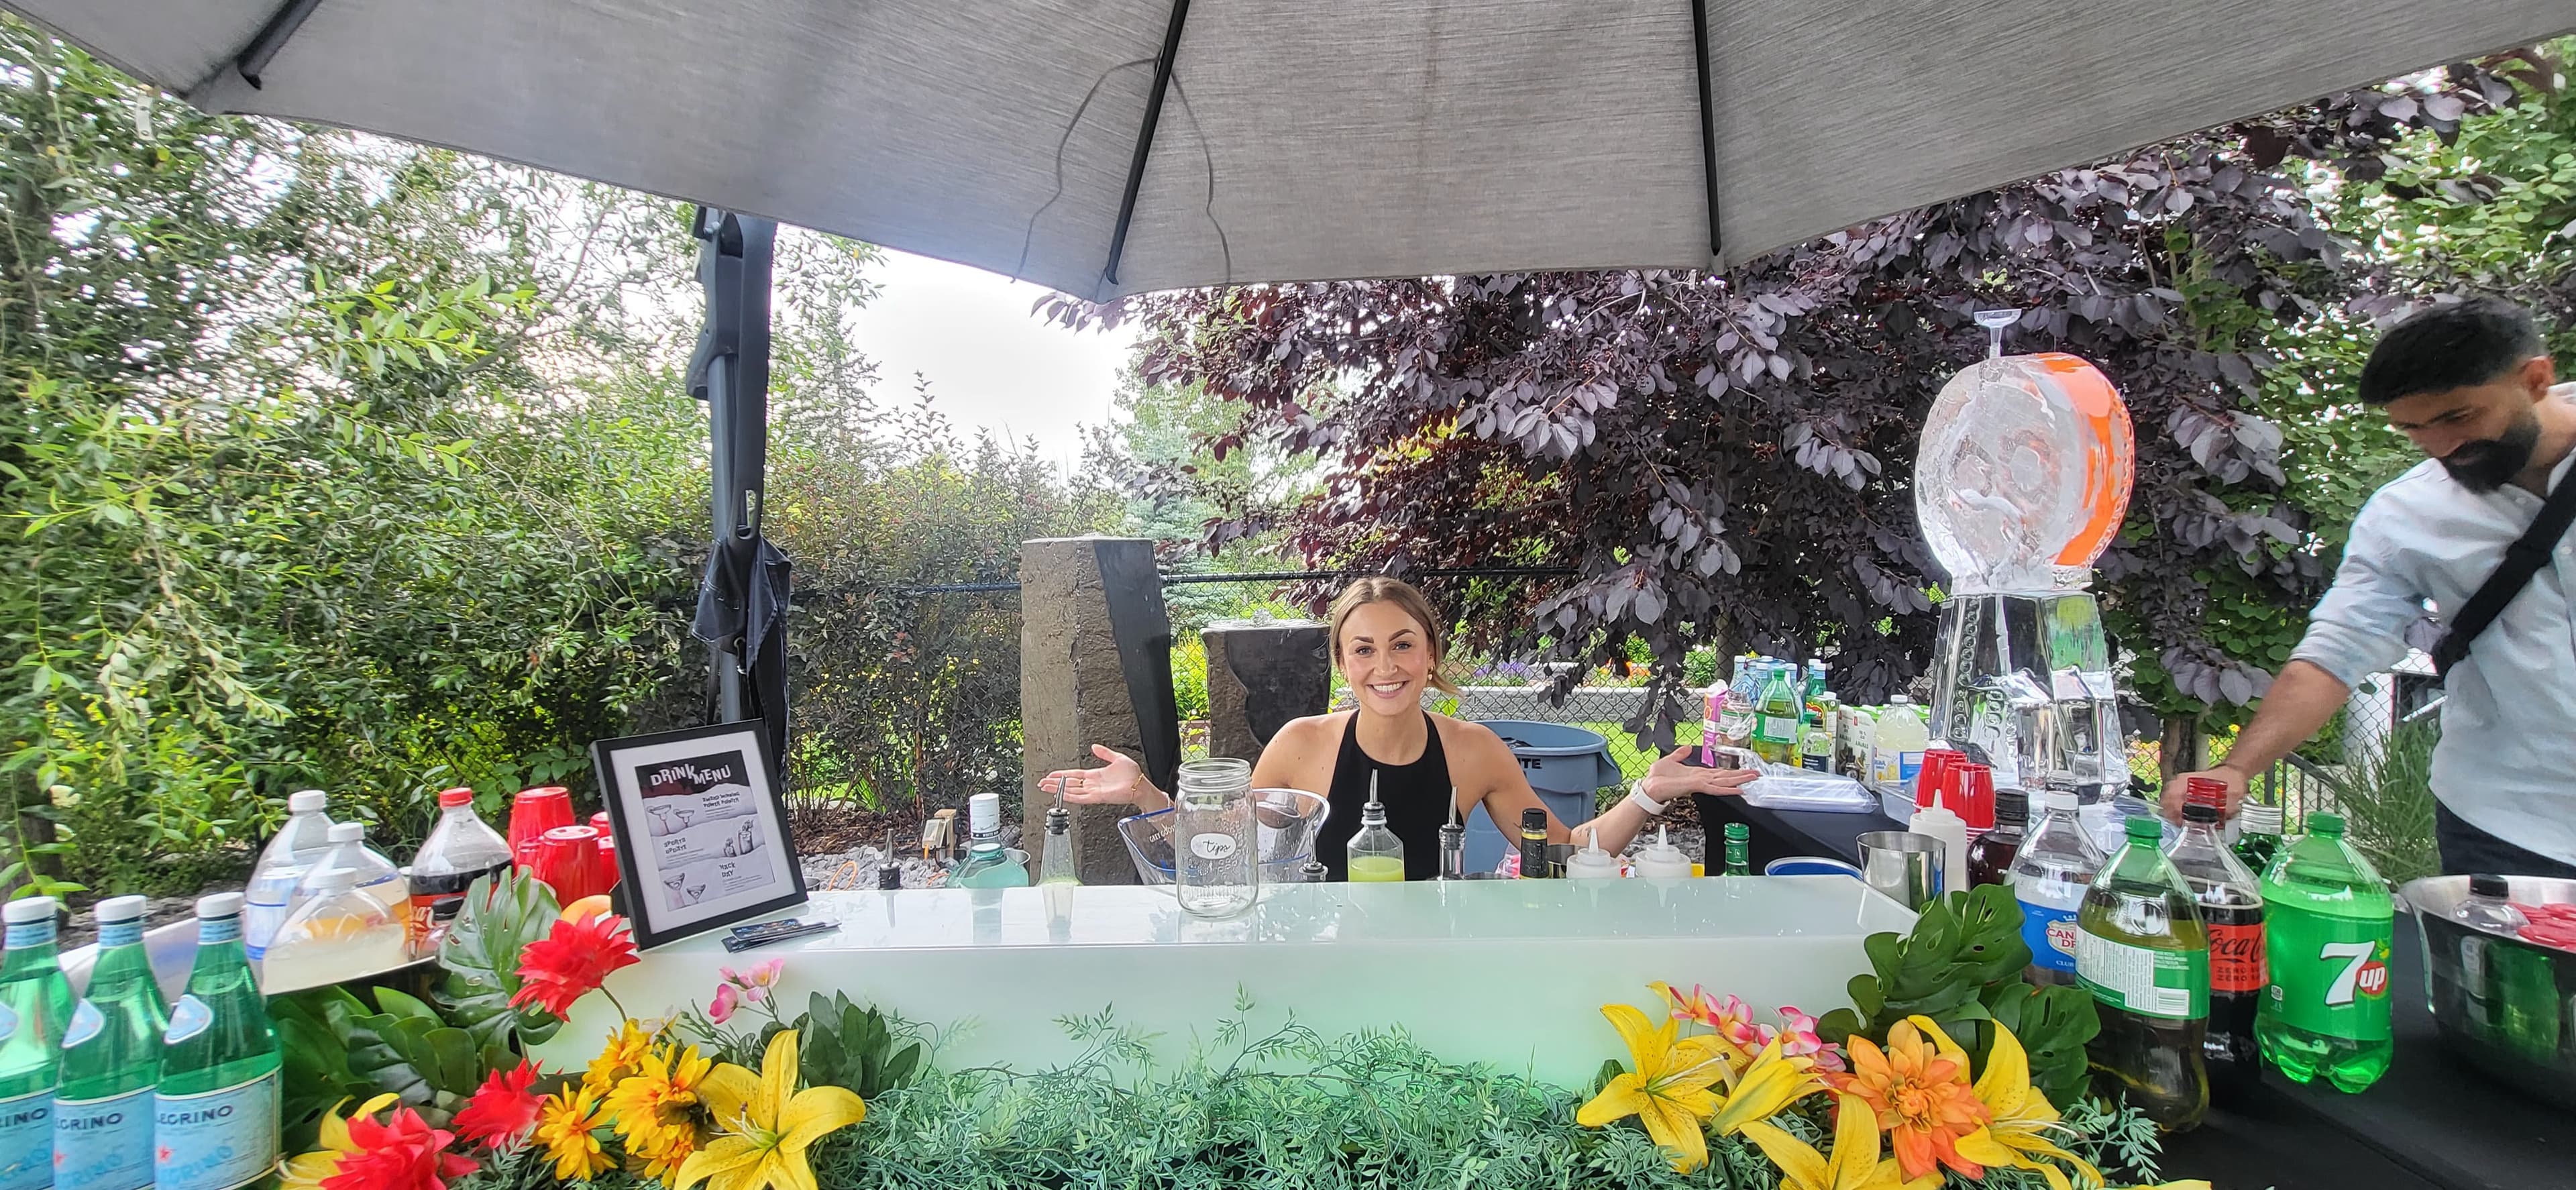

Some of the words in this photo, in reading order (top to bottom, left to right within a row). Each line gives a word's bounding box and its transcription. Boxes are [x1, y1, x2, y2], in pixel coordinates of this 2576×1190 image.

[1517, 757, 1542, 769] TE
[649, 763, 695, 786] DRINK
[693, 764, 731, 785] MENU
